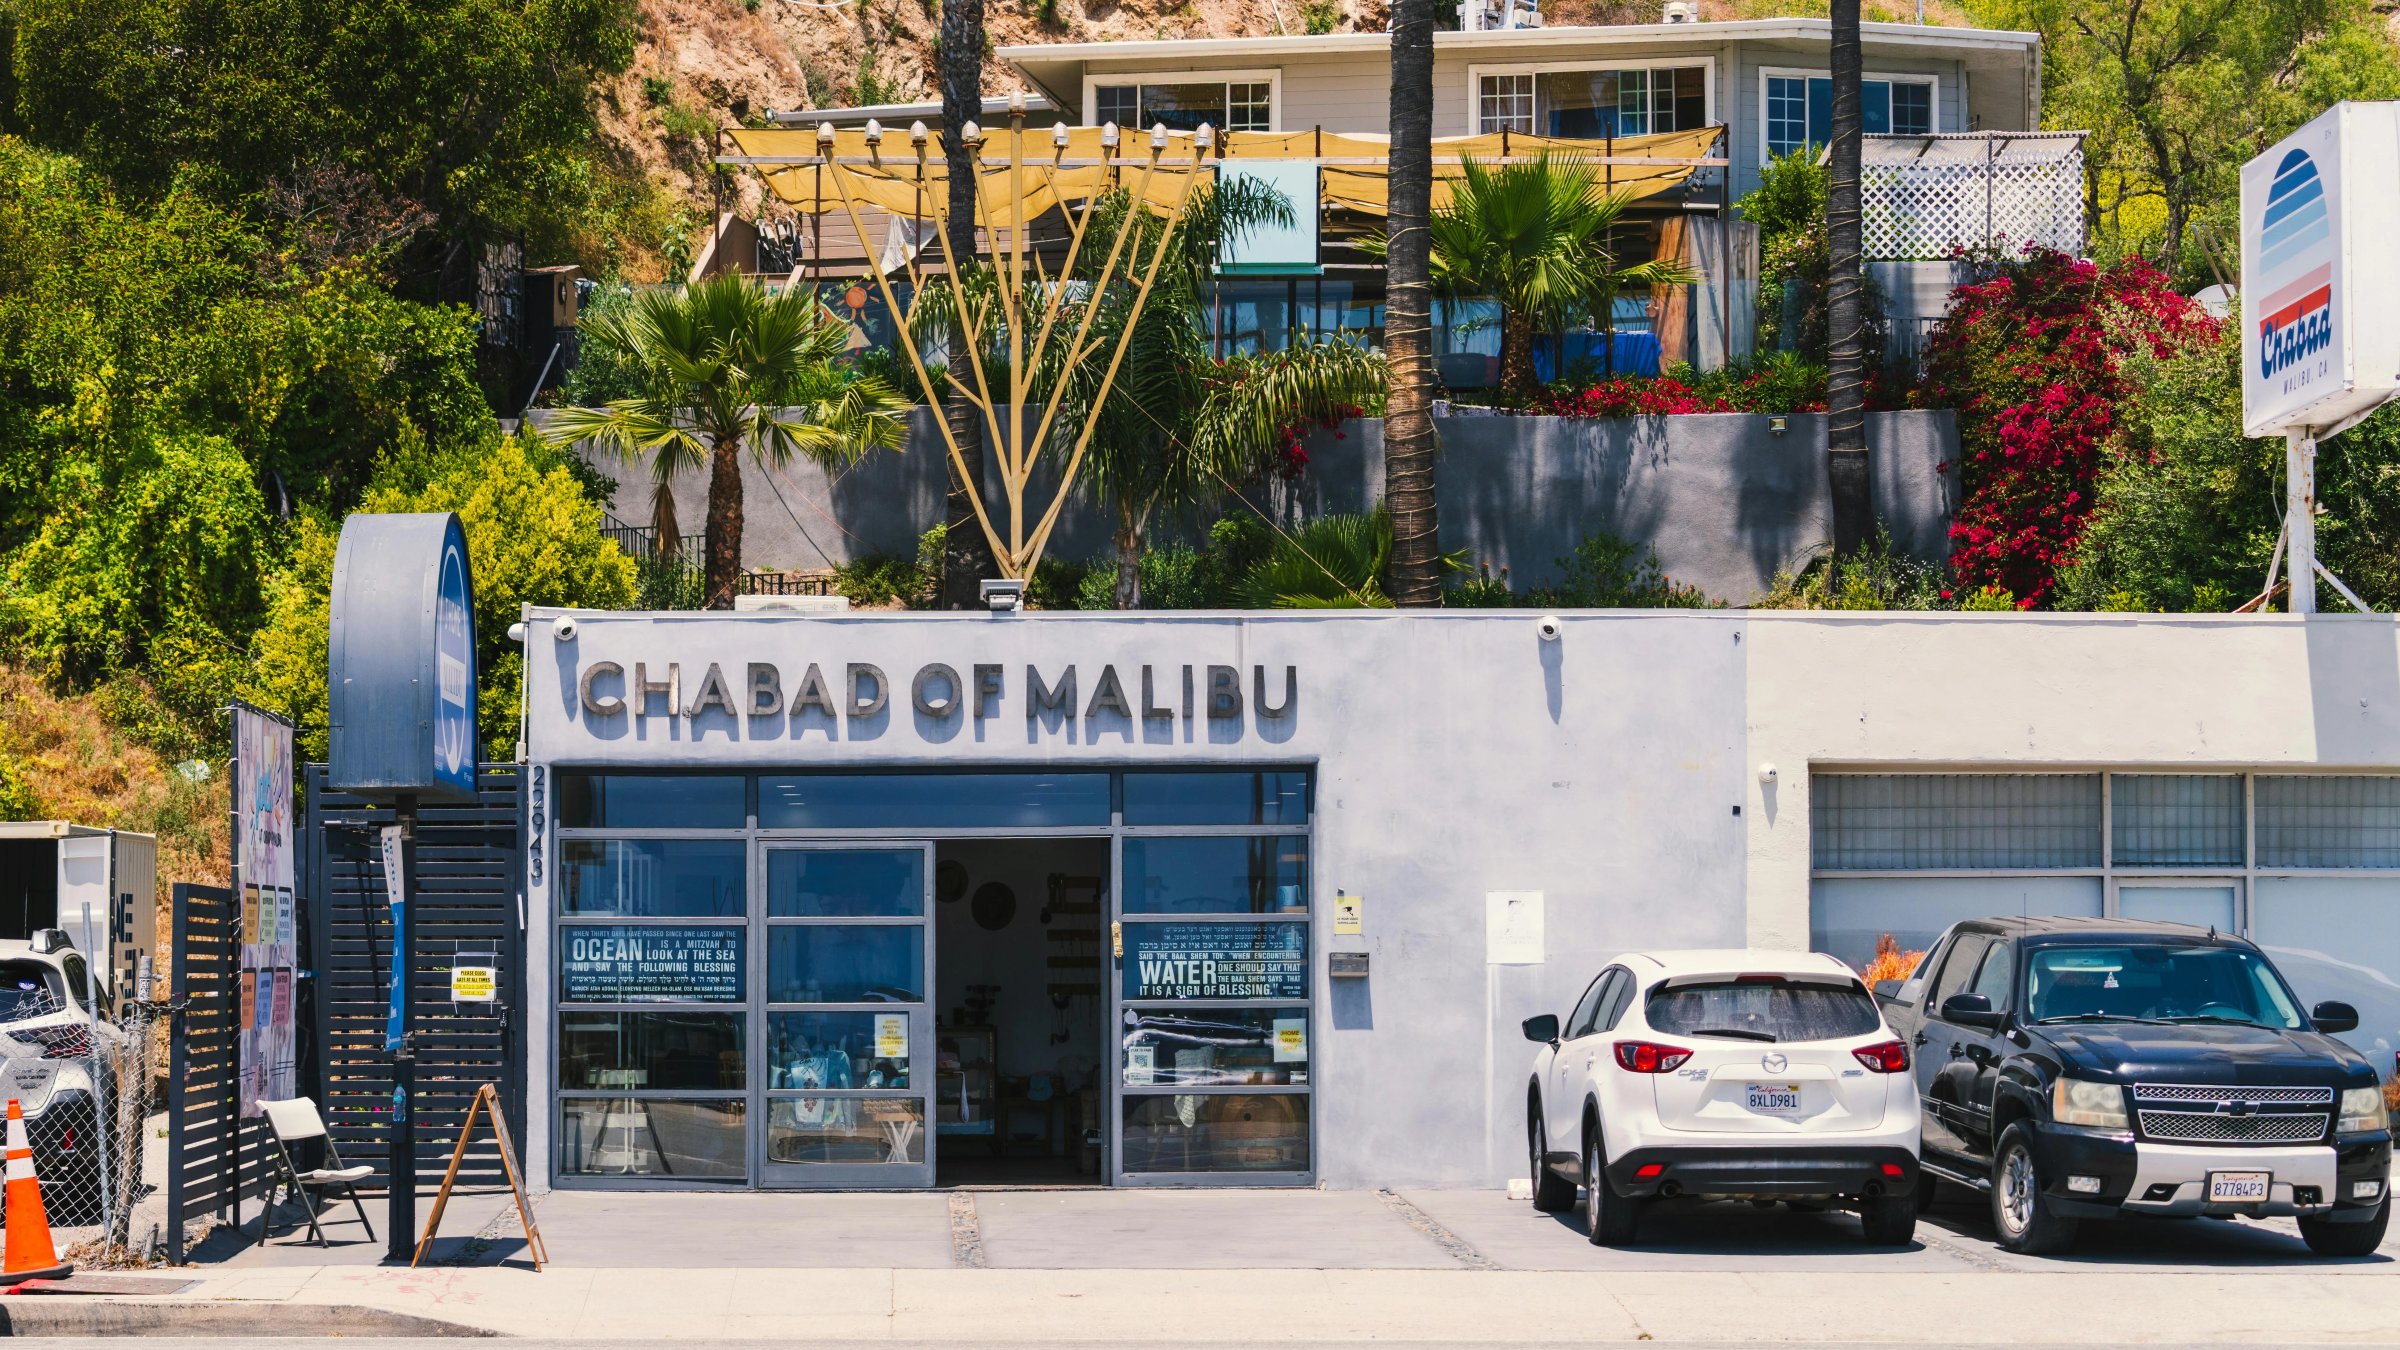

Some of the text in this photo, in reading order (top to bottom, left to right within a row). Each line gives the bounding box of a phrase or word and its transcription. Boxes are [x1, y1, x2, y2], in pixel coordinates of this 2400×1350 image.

[2261, 287, 2332, 379] Chabad
[580, 661, 1297, 719] CHABAD OF MALIBU
[529, 765, 545, 879] 22943
[572, 938, 643, 960] OCEAN
[661, 940, 669, 948] IS
[675, 940, 680, 948] A
[686, 940, 720, 948] MITZVAH
[726, 940, 736, 948] TO
[646, 950, 736, 960] LOOK AT THE SEA
[572, 962, 736, 972] AND SAY THE FOLLOWING BLESSING
[1139, 960, 1217, 984] WATER
[1218, 964, 1300, 972] ONE SHOULD SAY THAT
[1217, 975, 1301, 983] THE BAAL SHEM SAYS THAT
[1139, 986, 1148, 996] IT
[1152, 986, 1162, 996] IS
[1165, 986, 1172, 997] A
[1176, 986, 1200, 996] SIGN
[1204, 986, 1216, 996] OF
[1750, 1094, 1797, 1108] 8XLD981
[2214, 1182, 2264, 1196] 87784P3
